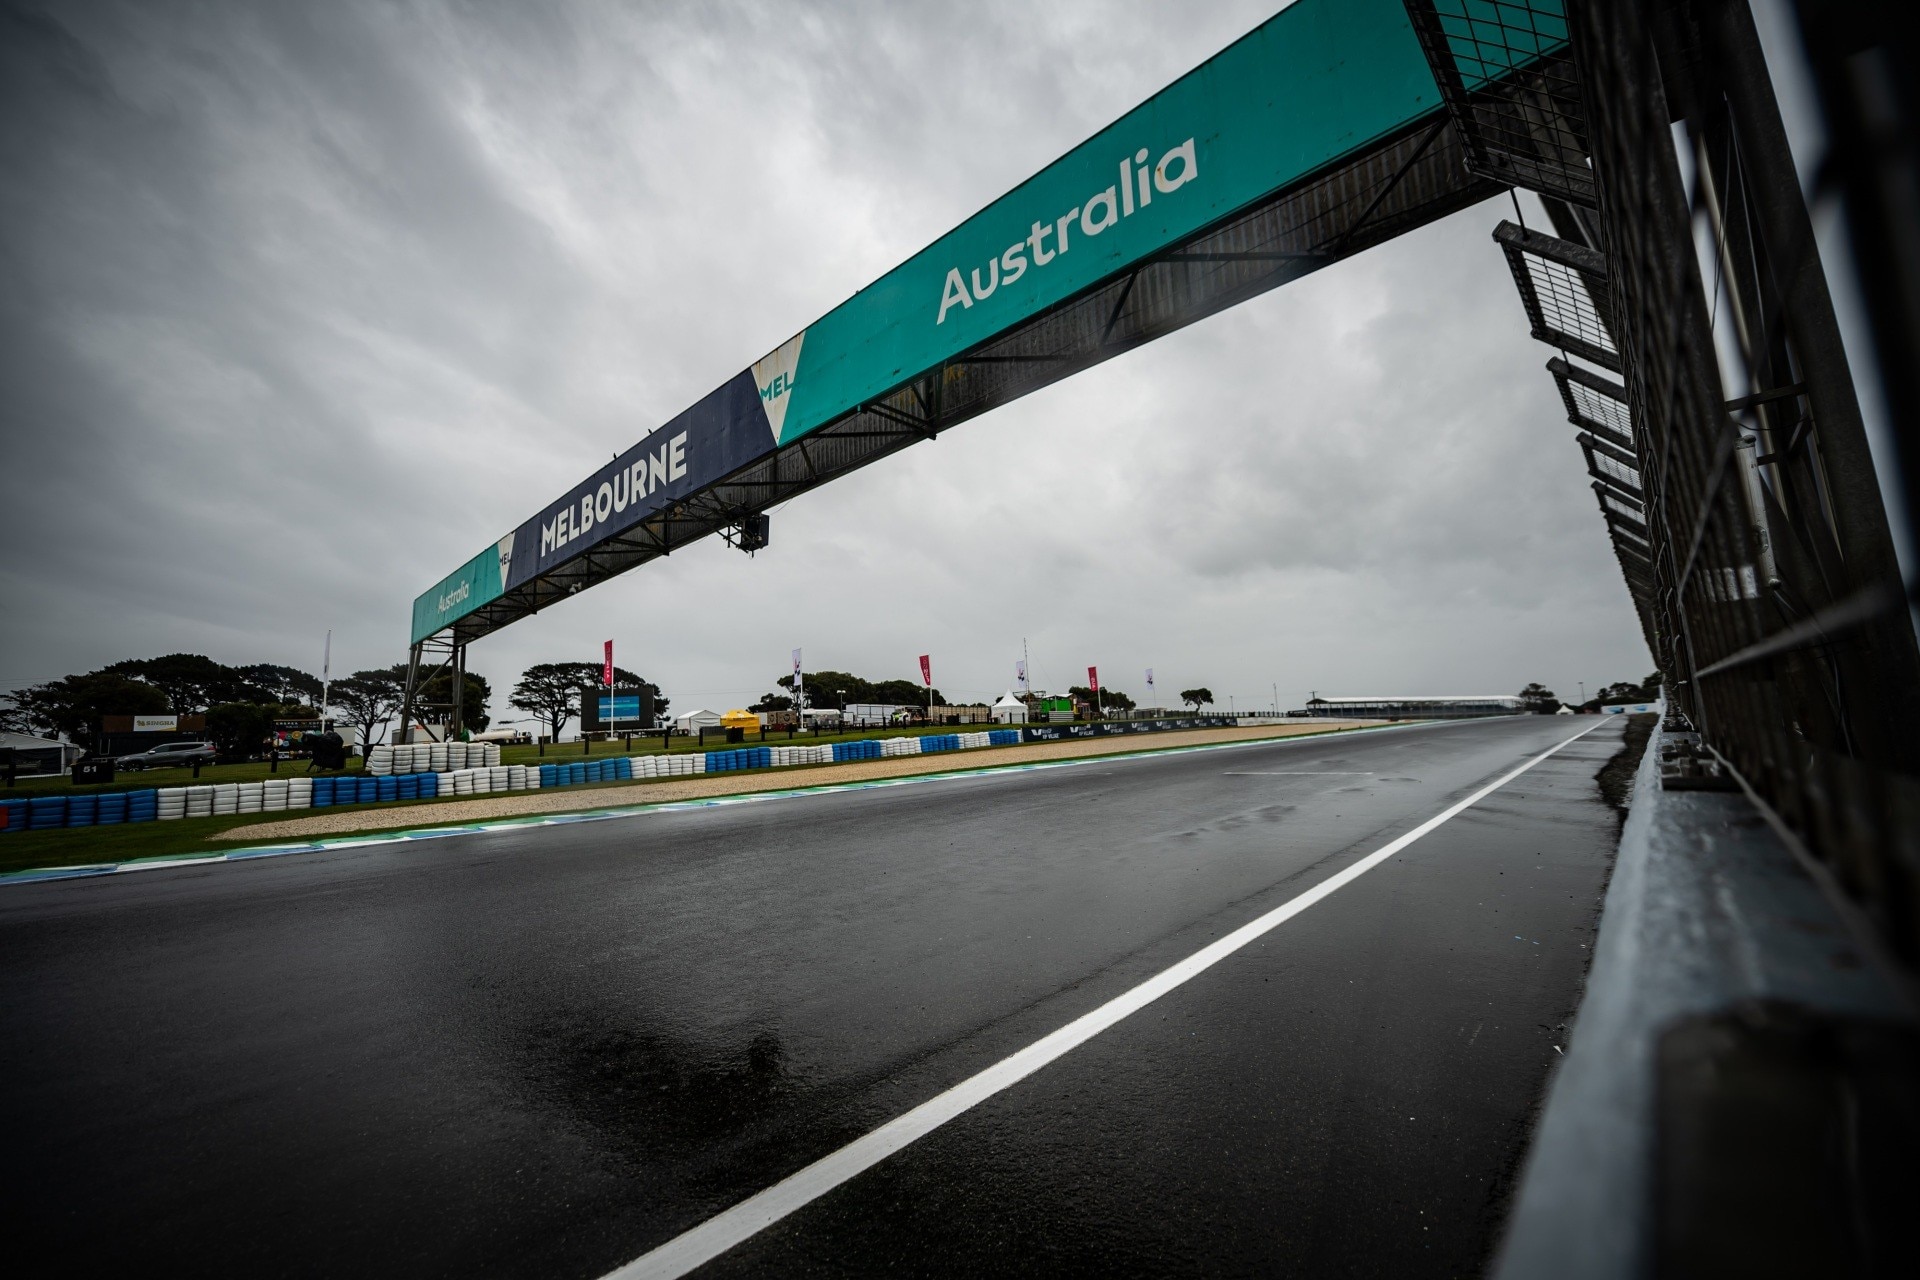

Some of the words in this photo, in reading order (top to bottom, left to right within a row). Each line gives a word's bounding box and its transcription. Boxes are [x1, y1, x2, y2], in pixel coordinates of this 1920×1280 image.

[936, 137, 1198, 325] Australia
[760, 371, 795, 402] MEL
[541, 430, 687, 558] MELBOURNE
[438, 580, 470, 614] Australia
[83, 765, 97, 773] 51
